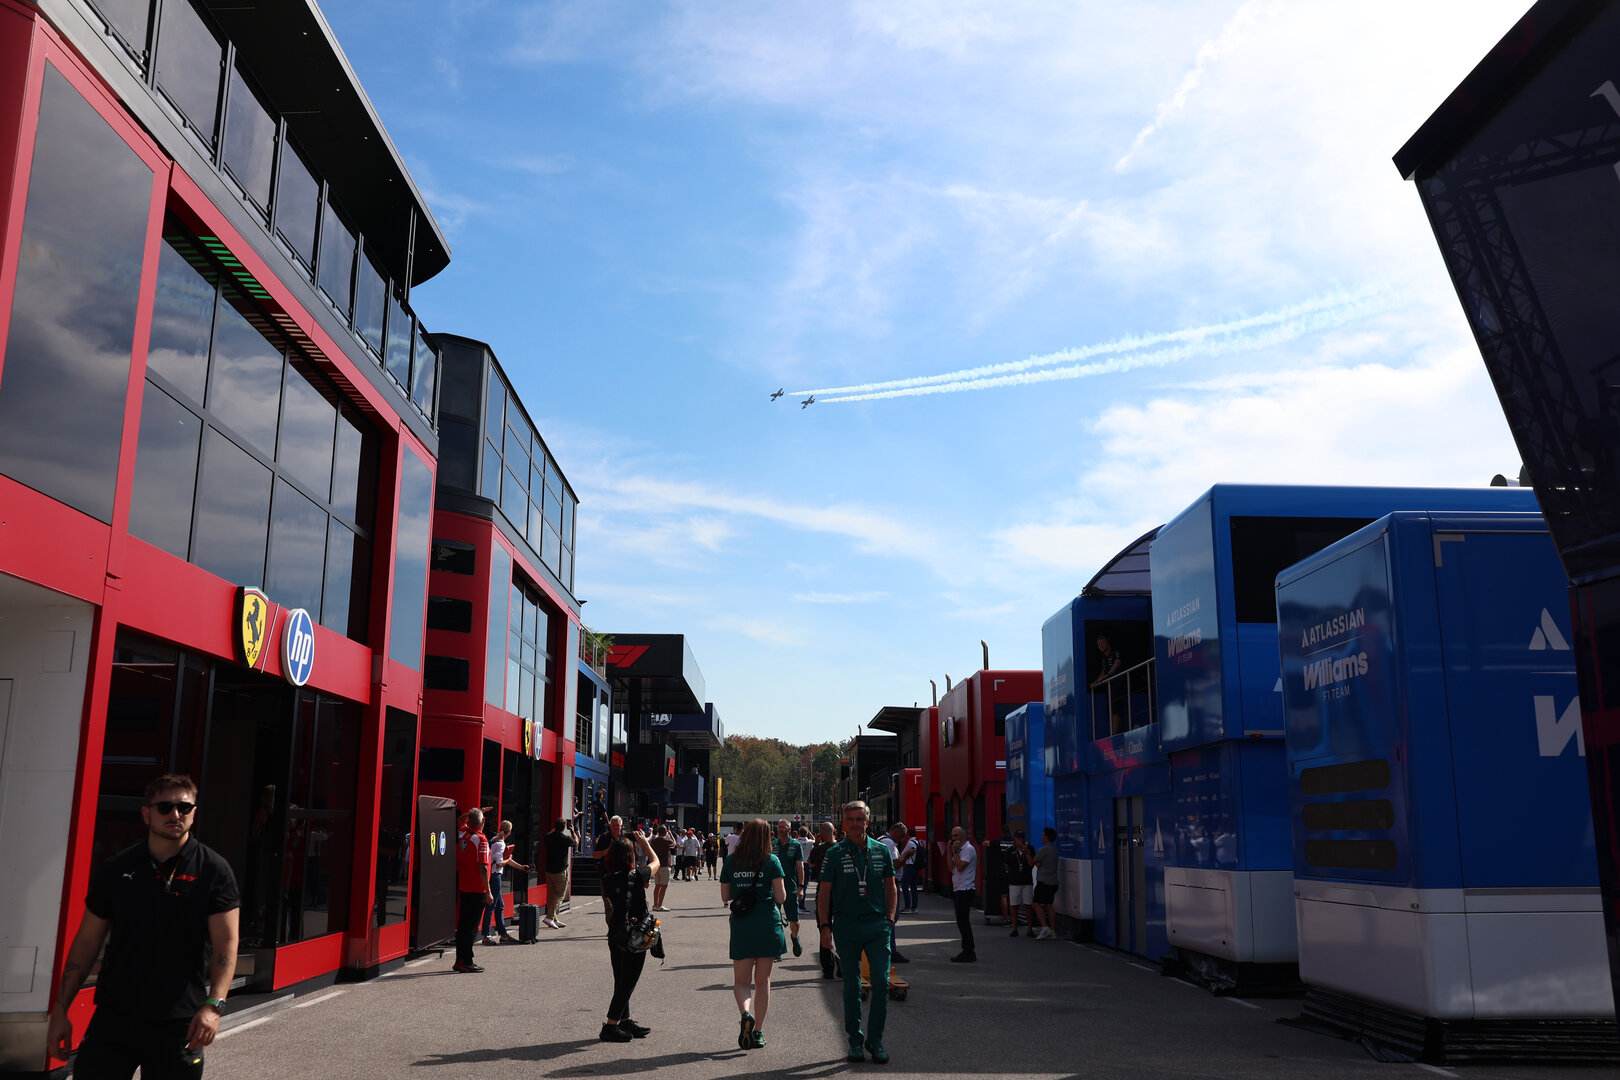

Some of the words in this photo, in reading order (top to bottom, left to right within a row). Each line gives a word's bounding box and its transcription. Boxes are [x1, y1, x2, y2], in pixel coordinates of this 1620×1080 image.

[1309, 607, 1366, 645] ATLASSIAN
[290, 612, 312, 681] hp
[1303, 651, 1368, 692] Williams
[1331, 685, 1351, 699] TEAM
